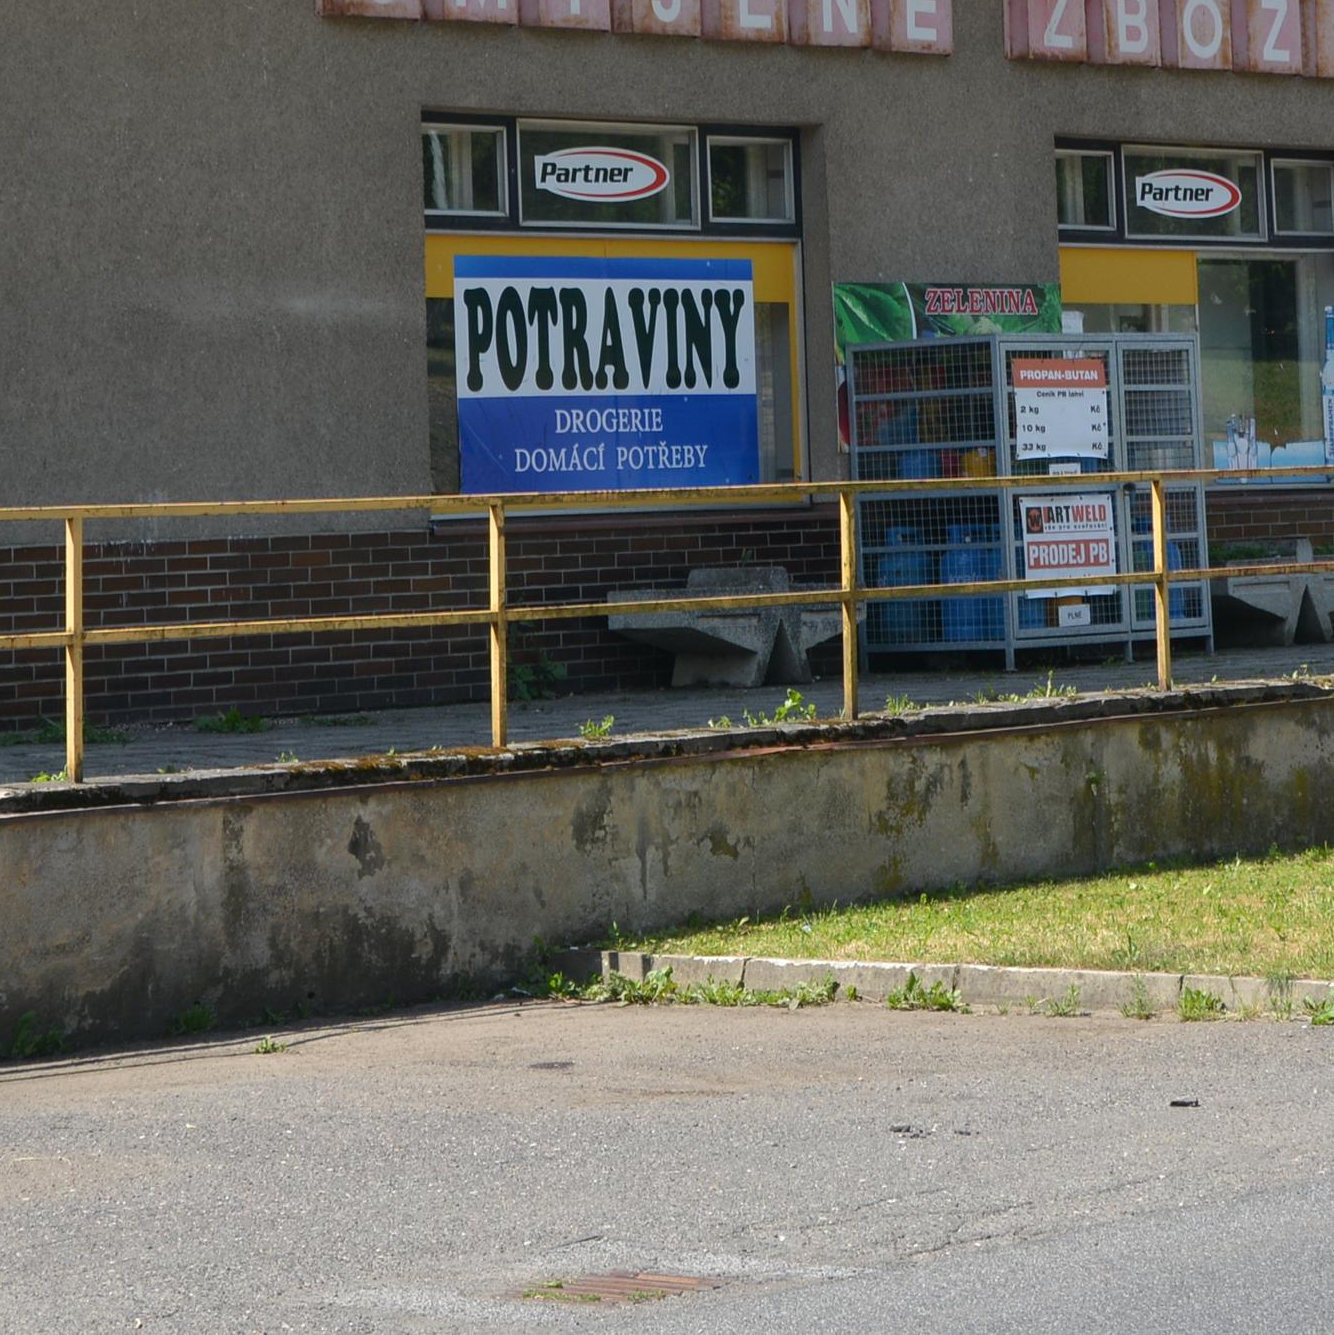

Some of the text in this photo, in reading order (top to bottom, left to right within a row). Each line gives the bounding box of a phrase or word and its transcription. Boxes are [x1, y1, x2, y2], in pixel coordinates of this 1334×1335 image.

[539, 162, 634, 184] Partner
[1139, 183, 1214, 202] Partner
[925, 288, 1039, 315] ZELENINA
[463, 286, 745, 392] POTRAVINY
[555, 408, 664, 434] DROGERIE
[1029, 406, 1039, 414] kg
[1090, 405, 1100, 413] Kč
[1035, 424, 1045, 433] kg
[1091, 423, 1101, 431] Kč
[514, 441, 708, 473] DOMÁCÍ POTŘEBY
[1036, 443, 1046, 452] kg
[1092, 442, 1102, 450] Kč
[1029, 542, 1108, 567] PRODEJ PB
